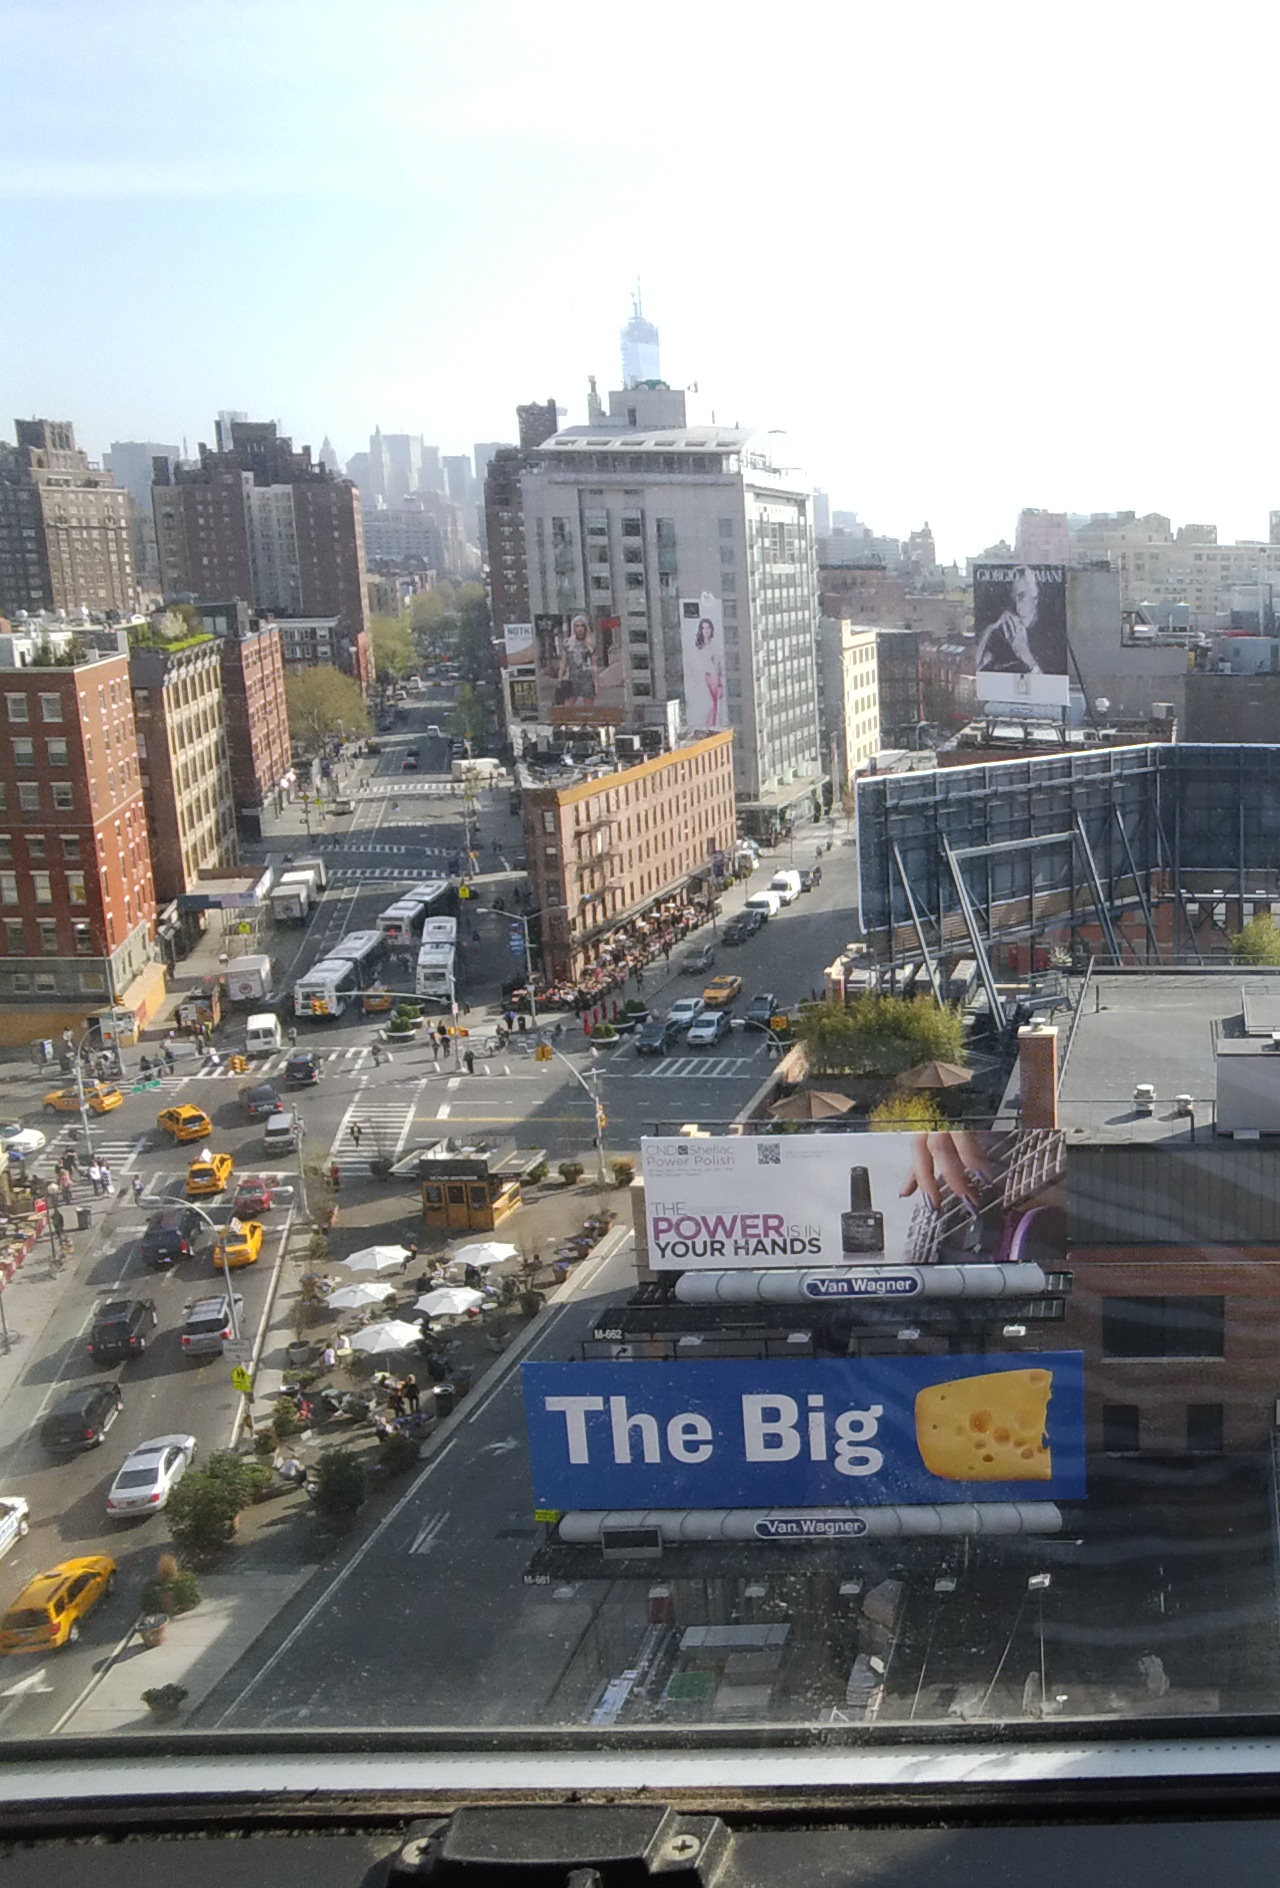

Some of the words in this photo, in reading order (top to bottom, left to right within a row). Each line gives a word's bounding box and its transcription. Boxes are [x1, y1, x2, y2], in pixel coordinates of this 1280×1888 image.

[976, 569, 1019, 582] GIORGIO
[690, 1145, 734, 1155] Shellac
[647, 1156, 689, 1167] Power
[695, 1155, 735, 1166] Polish
[651, 1202, 687, 1216] THE
[652, 1213, 785, 1241] POWER
[787, 1225, 801, 1237] IS
[805, 1224, 821, 1237] IN
[654, 1241, 726, 1259] YOUR
[733, 1237, 822, 1256] HANDS
[817, 1279, 849, 1293] Van
[851, 1278, 912, 1294] Wagner
[545, 1395, 714, 1464] The
[741, 1393, 884, 1476] Big
[767, 1521, 797, 1533] Van
[800, 1520, 862, 1534] Wagner
